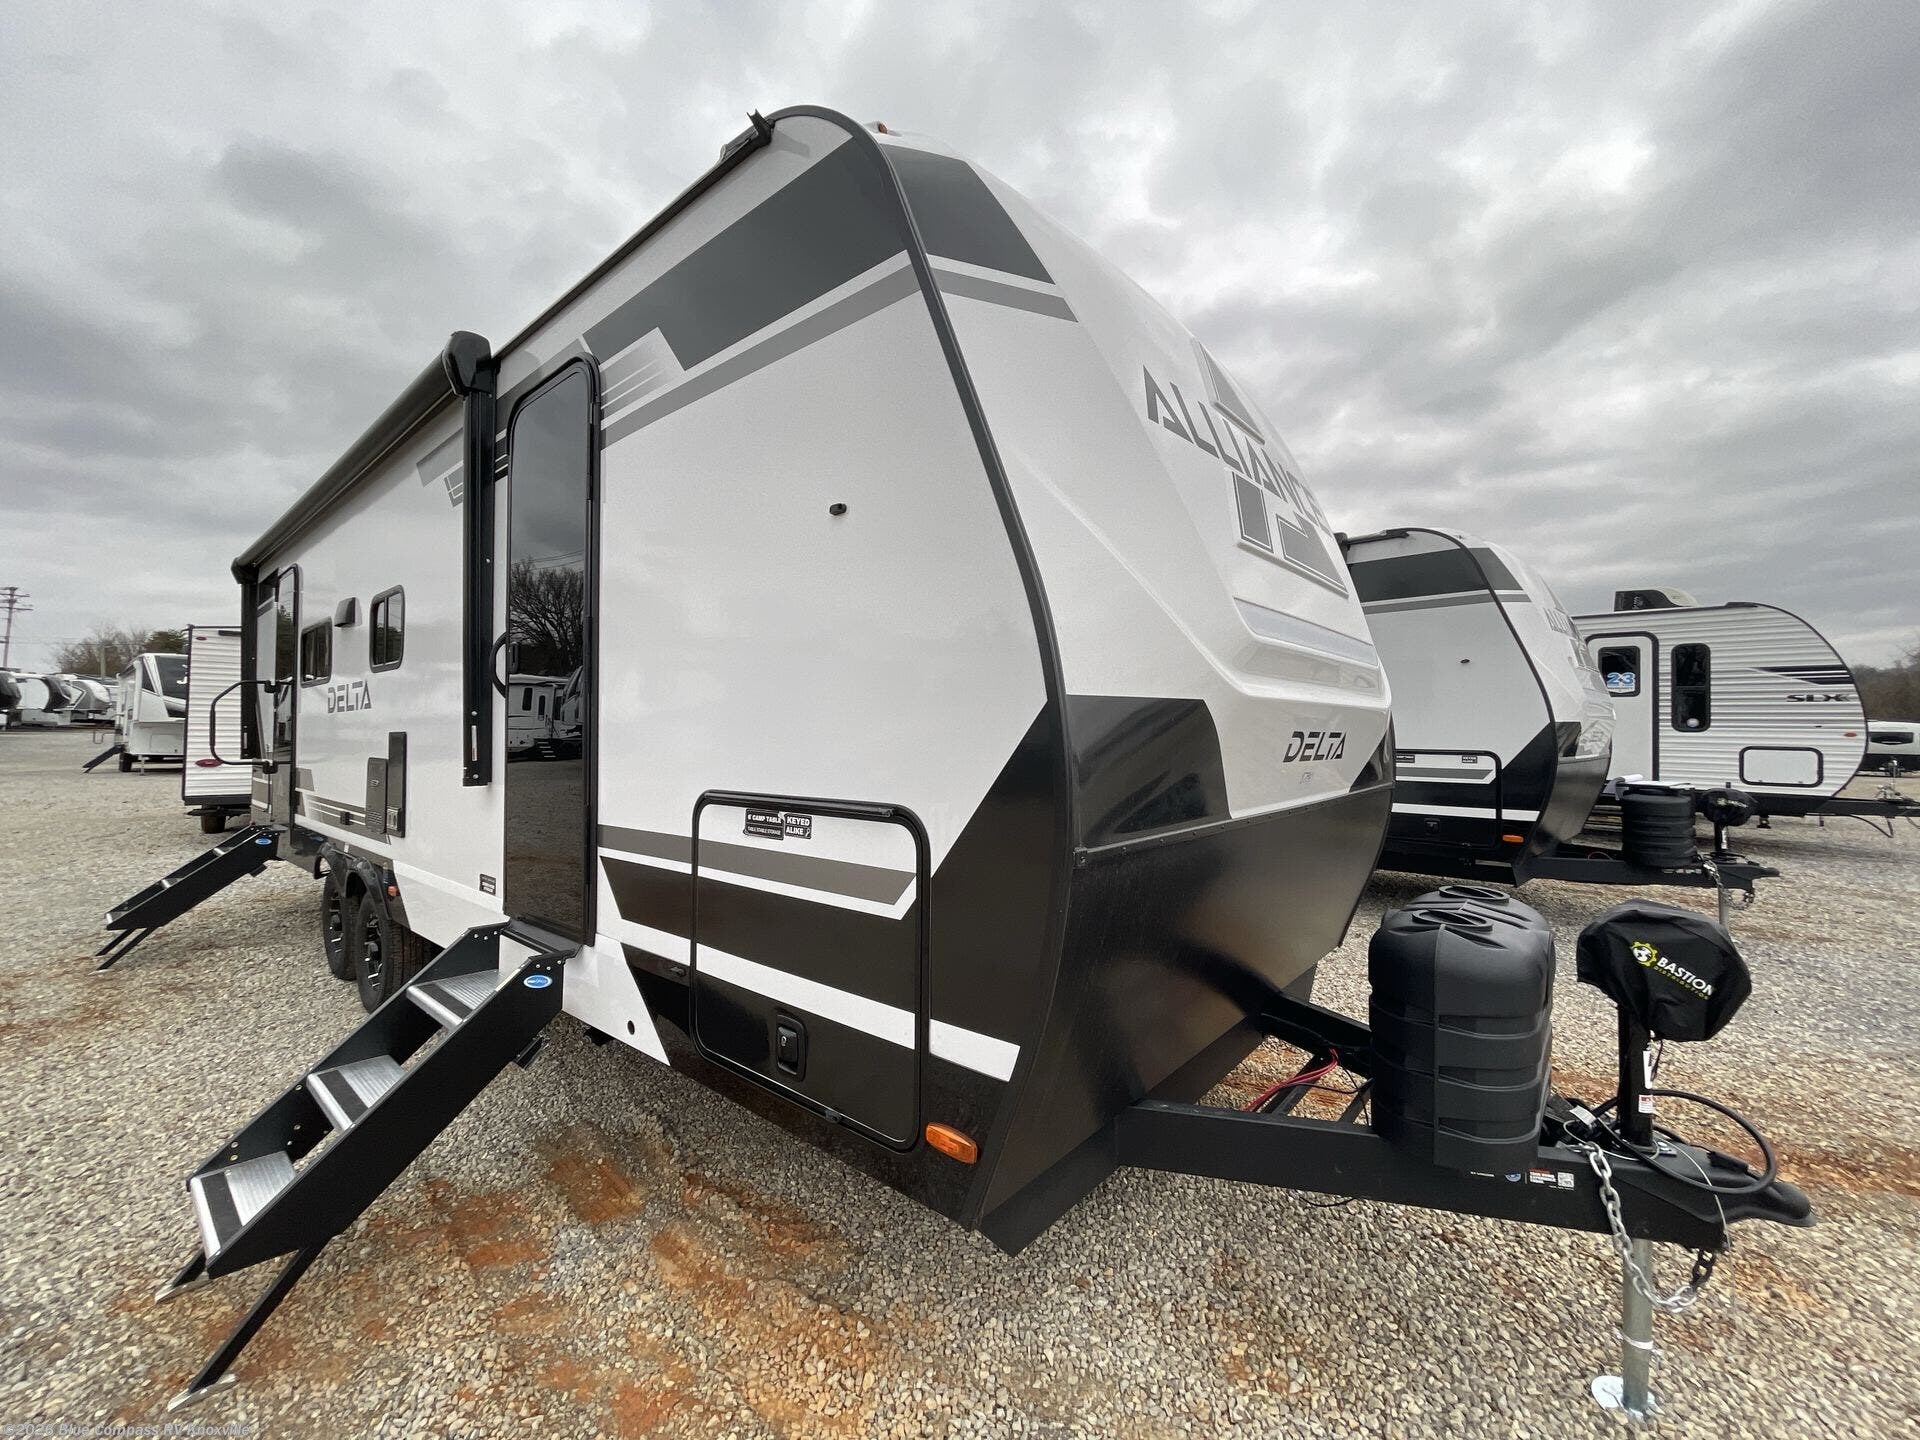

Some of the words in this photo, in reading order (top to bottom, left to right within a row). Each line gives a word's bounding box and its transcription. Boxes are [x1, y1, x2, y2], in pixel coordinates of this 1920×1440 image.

[327, 679, 372, 713] DELTA
[1283, 731, 1347, 763] DELTA
[786, 826, 804, 835] ALIKE
[787, 816, 810, 826] KEYED
[1656, 957, 1715, 996] BASTION
